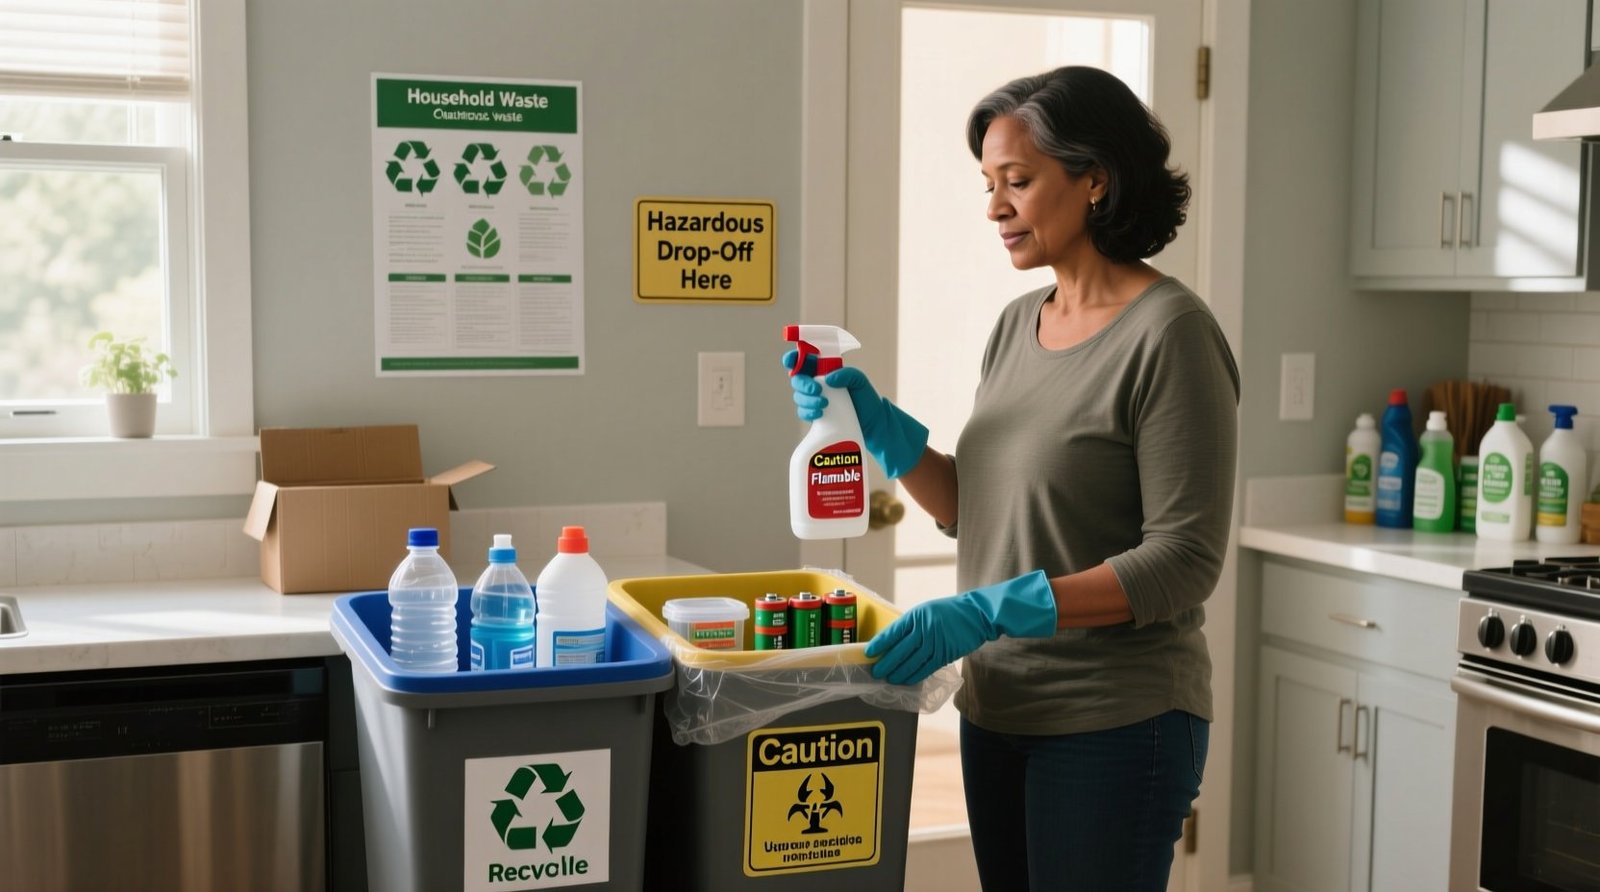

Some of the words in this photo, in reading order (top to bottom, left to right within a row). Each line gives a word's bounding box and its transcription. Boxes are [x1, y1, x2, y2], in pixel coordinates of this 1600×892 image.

[407, 88, 495, 106] Household
[499, 91, 548, 108] Waste
[648, 211, 764, 233] Hazardous
[657, 240, 754, 266] Drop-Off
[681, 268, 732, 290] Here
[759, 734, 873, 766] Caution
